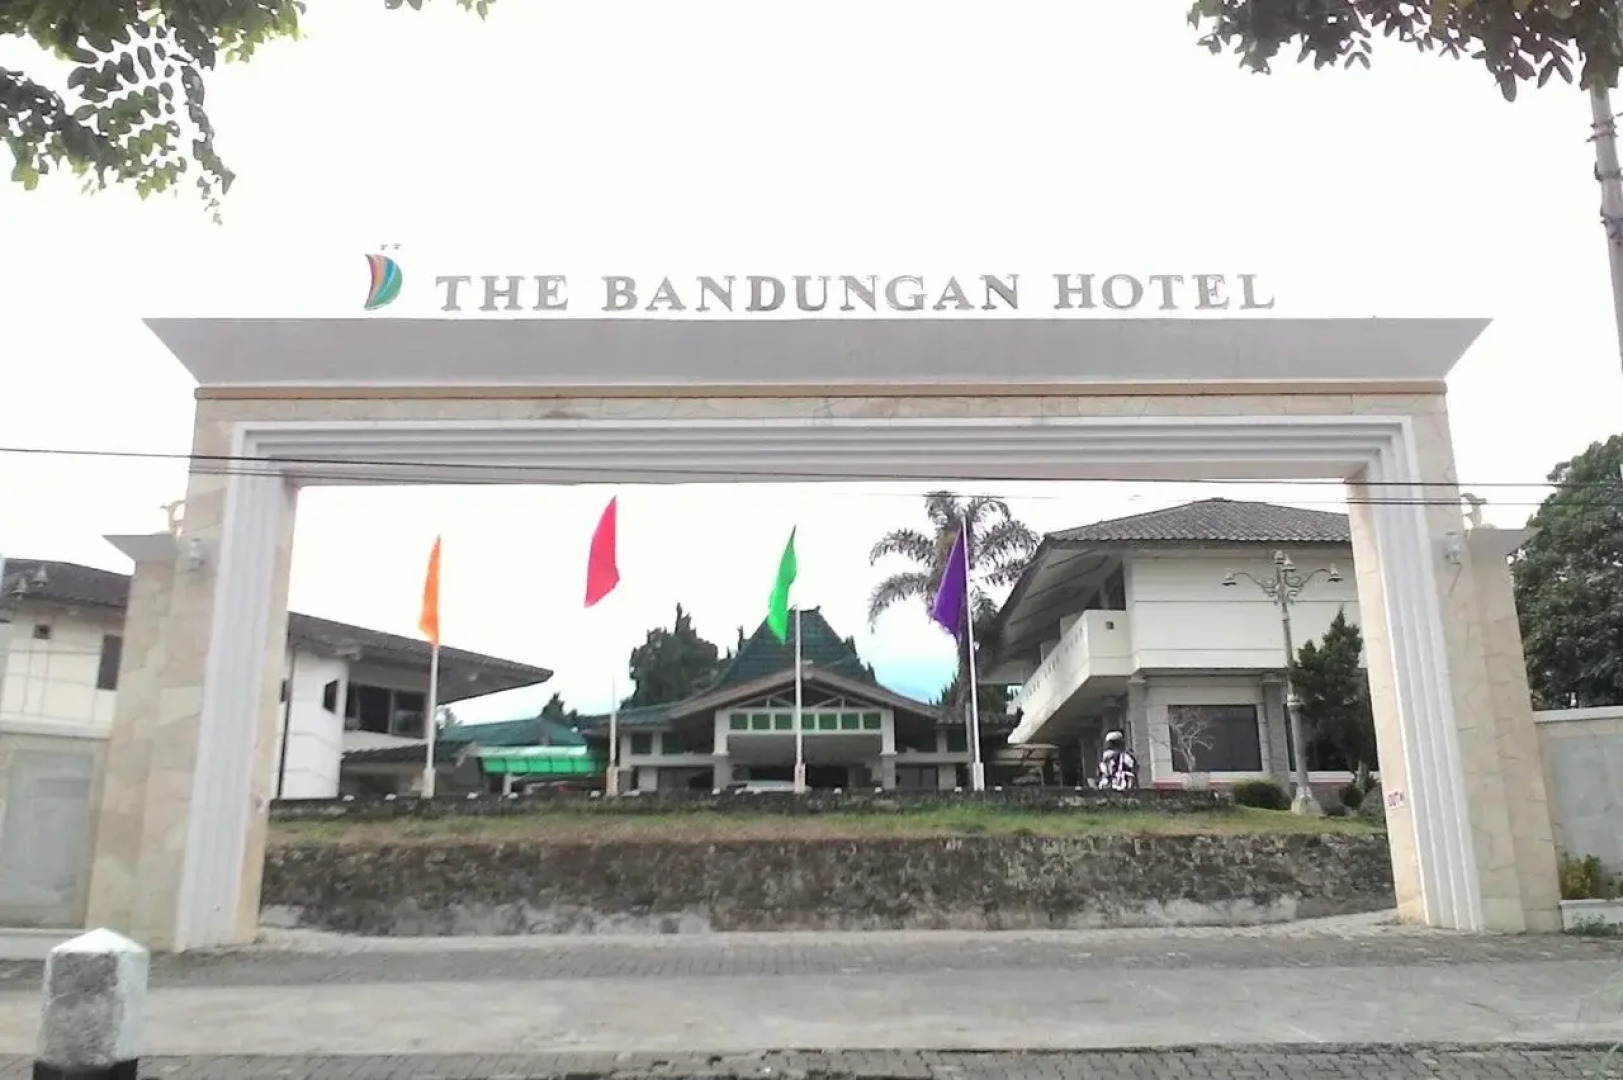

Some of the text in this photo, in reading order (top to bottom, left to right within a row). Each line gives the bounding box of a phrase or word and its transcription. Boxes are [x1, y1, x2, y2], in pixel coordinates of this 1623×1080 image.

[435, 273, 1275, 311] THE BANDUNGAN HOTEL
